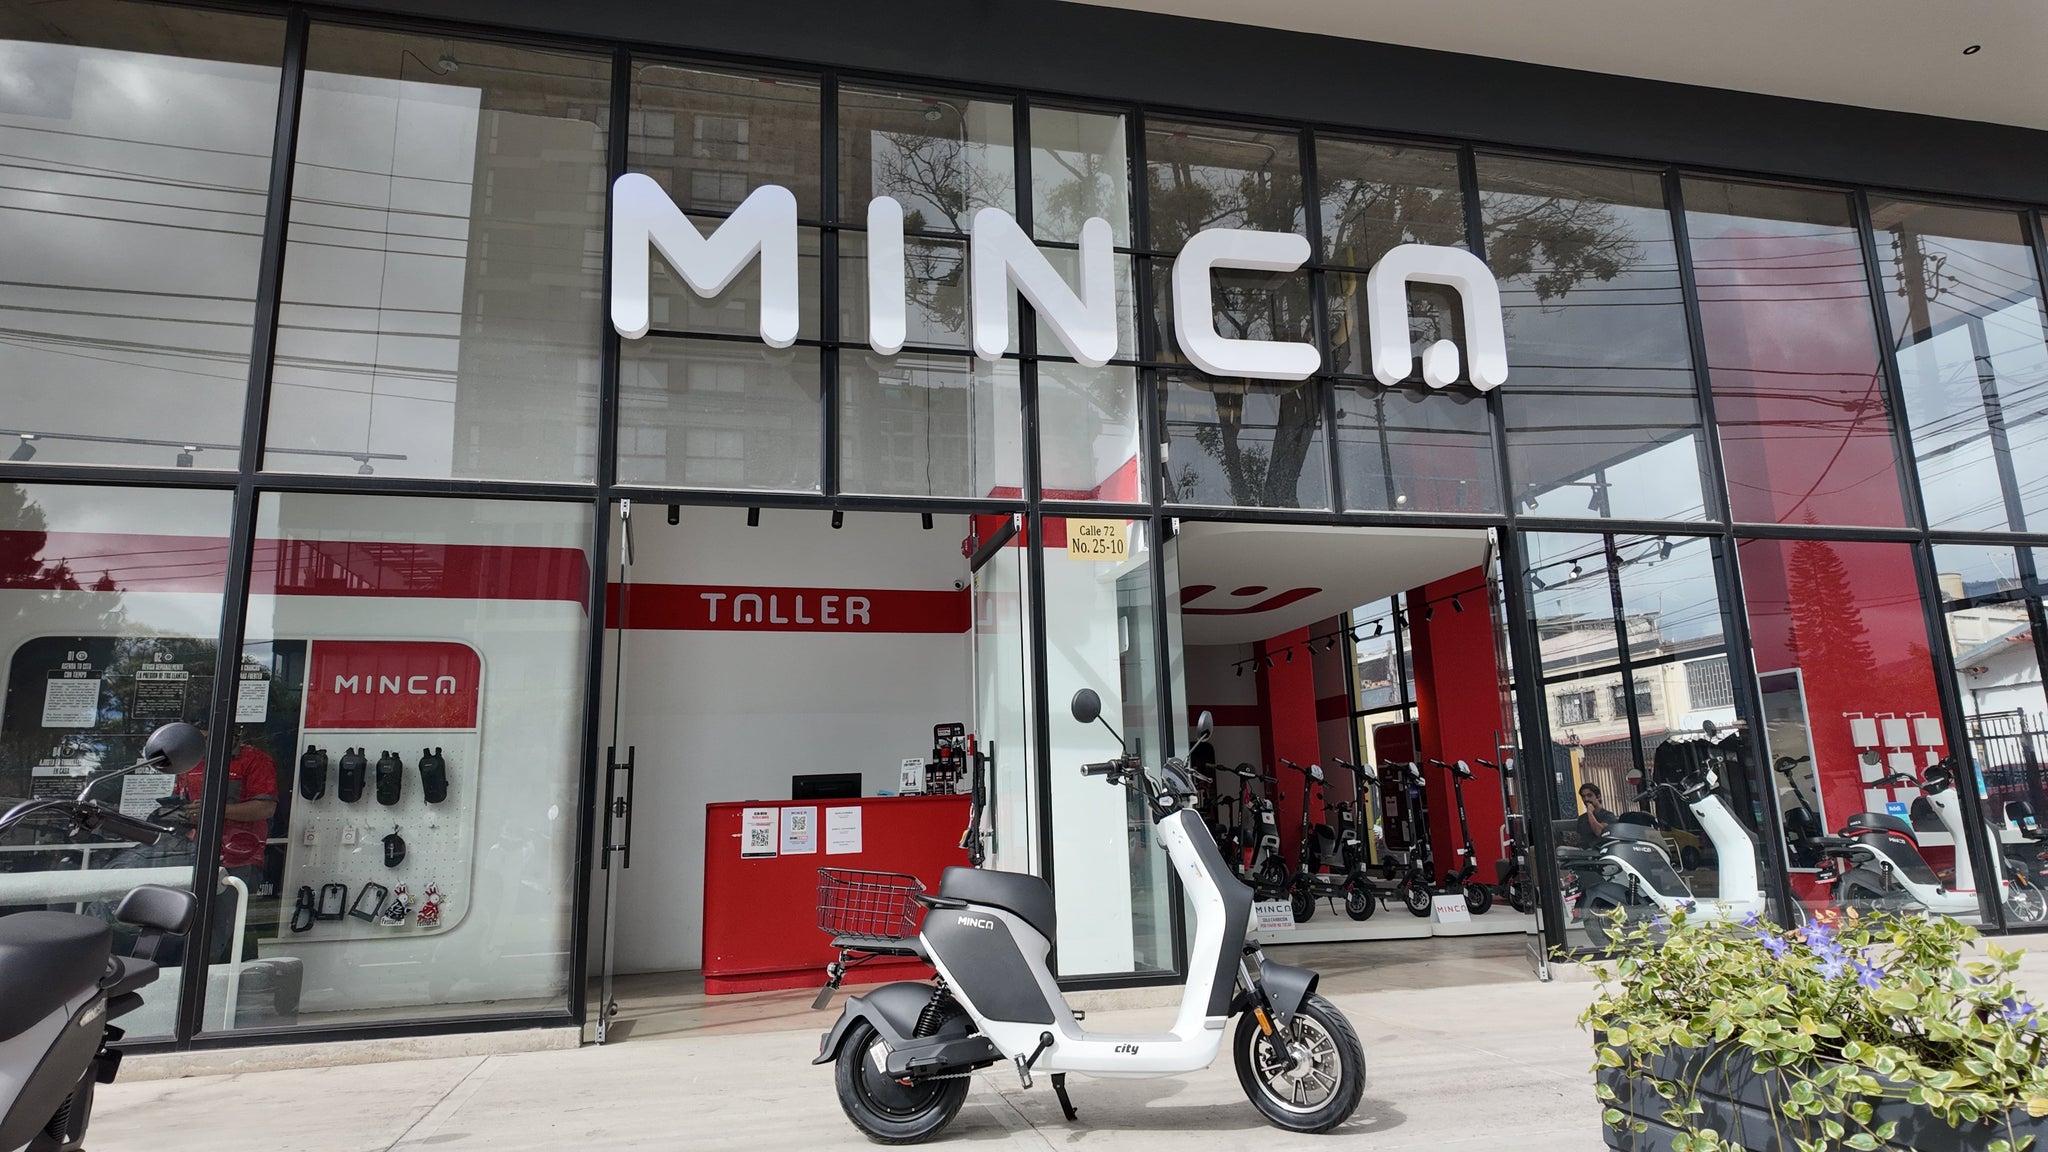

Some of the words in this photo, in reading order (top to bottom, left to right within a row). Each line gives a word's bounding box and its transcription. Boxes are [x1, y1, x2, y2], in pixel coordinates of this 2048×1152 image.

[610, 172, 1509, 392] MINCA
[1079, 525, 1101, 536] Calle
[1103, 526, 1115, 536] 72
[1072, 538, 1090, 553] No.
[1092, 538, 1124, 554] 25-10
[700, 593, 871, 625] TALLER
[334, 675, 456, 694] MINCA
[1255, 905, 1291, 914] MINCA
[1437, 905, 1467, 913] MINCA
[957, 916, 994, 930] MINCA
[1114, 1043, 1139, 1056] city
